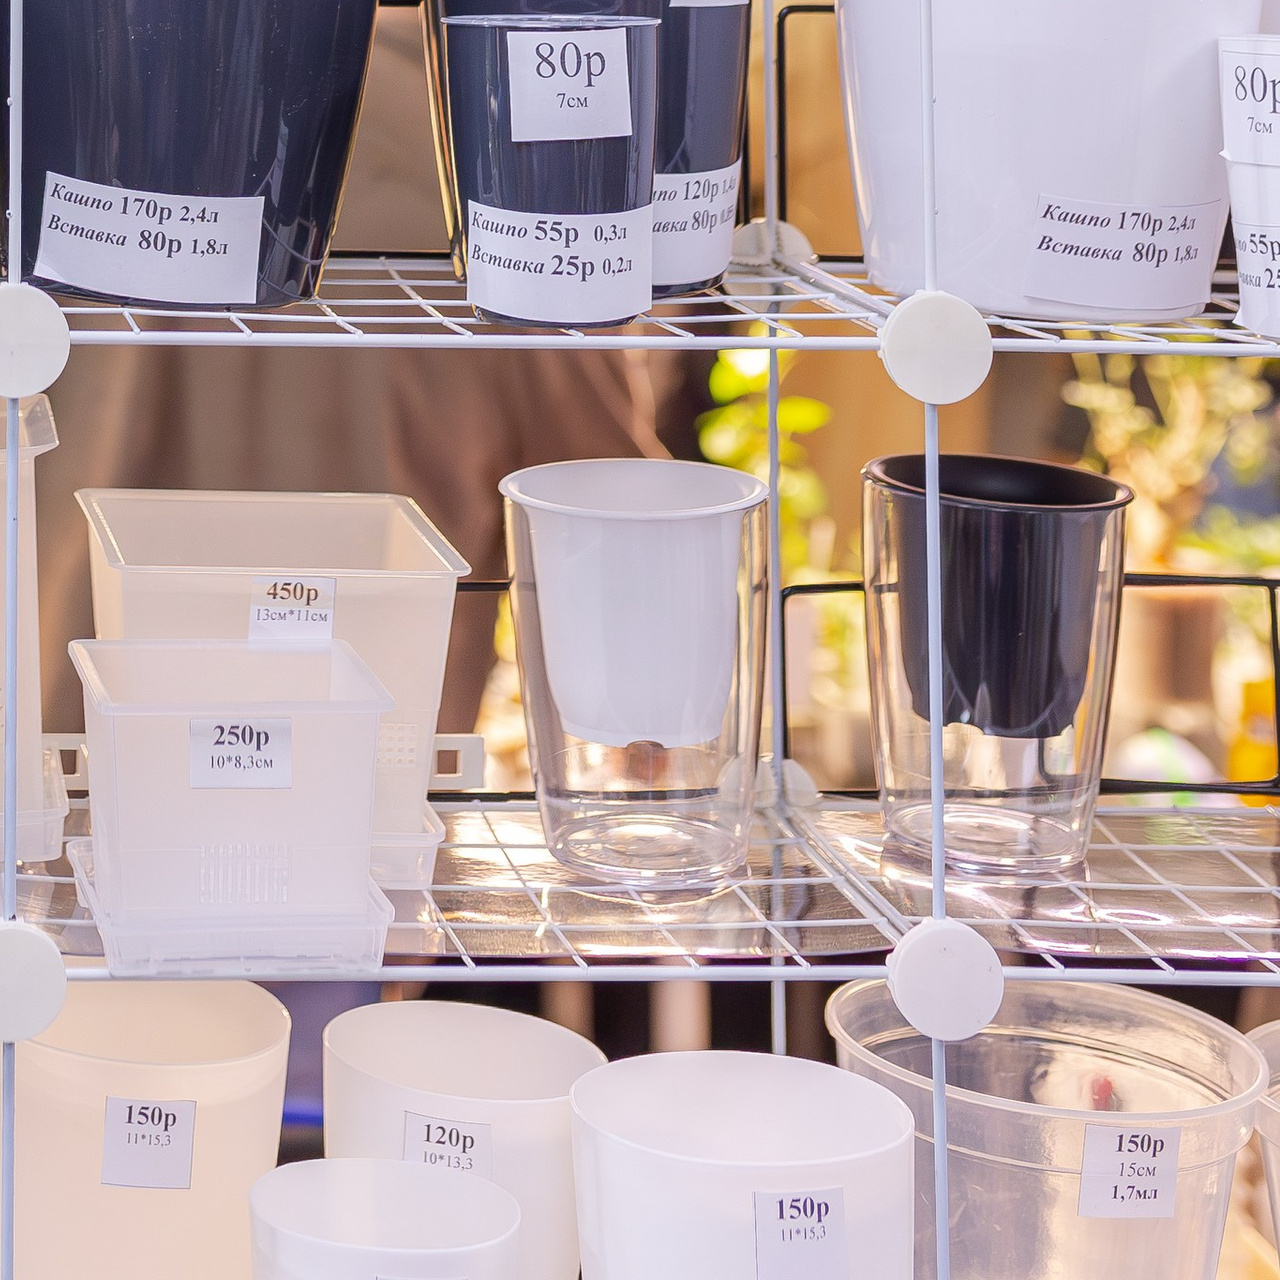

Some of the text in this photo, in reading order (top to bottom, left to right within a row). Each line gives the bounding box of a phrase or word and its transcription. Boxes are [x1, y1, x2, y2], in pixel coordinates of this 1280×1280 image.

[535, 41, 607, 88] 80р
[555, 92, 589, 109] 7см
[1246, 116, 1273, 134] 7см
[49, 181, 220, 226] Кашпо 170р 2,4л
[683, 178, 719, 203] 120р
[471, 210, 627, 248] Кашпо 55р 0,3л
[691, 209, 718, 234] 80р
[1040, 203, 1197, 237] Кашпо 170р 2,4л
[46, 212, 229, 259] Вставка 80р 1,8л
[471, 243, 633, 283] Вставка 25р 0,2л
[1036, 235, 1199, 269] Вставка 80р 1,8л
[266, 581, 319, 607] 450р
[213, 724, 270, 752] 250р
[124, 1104, 177, 1132] 150р
[422, 1123, 476, 1155] 120р
[1115, 1132, 1165, 1159] 150р
[1119, 1161, 1158, 1178] 15см
[1110, 1184, 1159, 1203] 1,7мл
[776, 1195, 830, 1224] 150р
